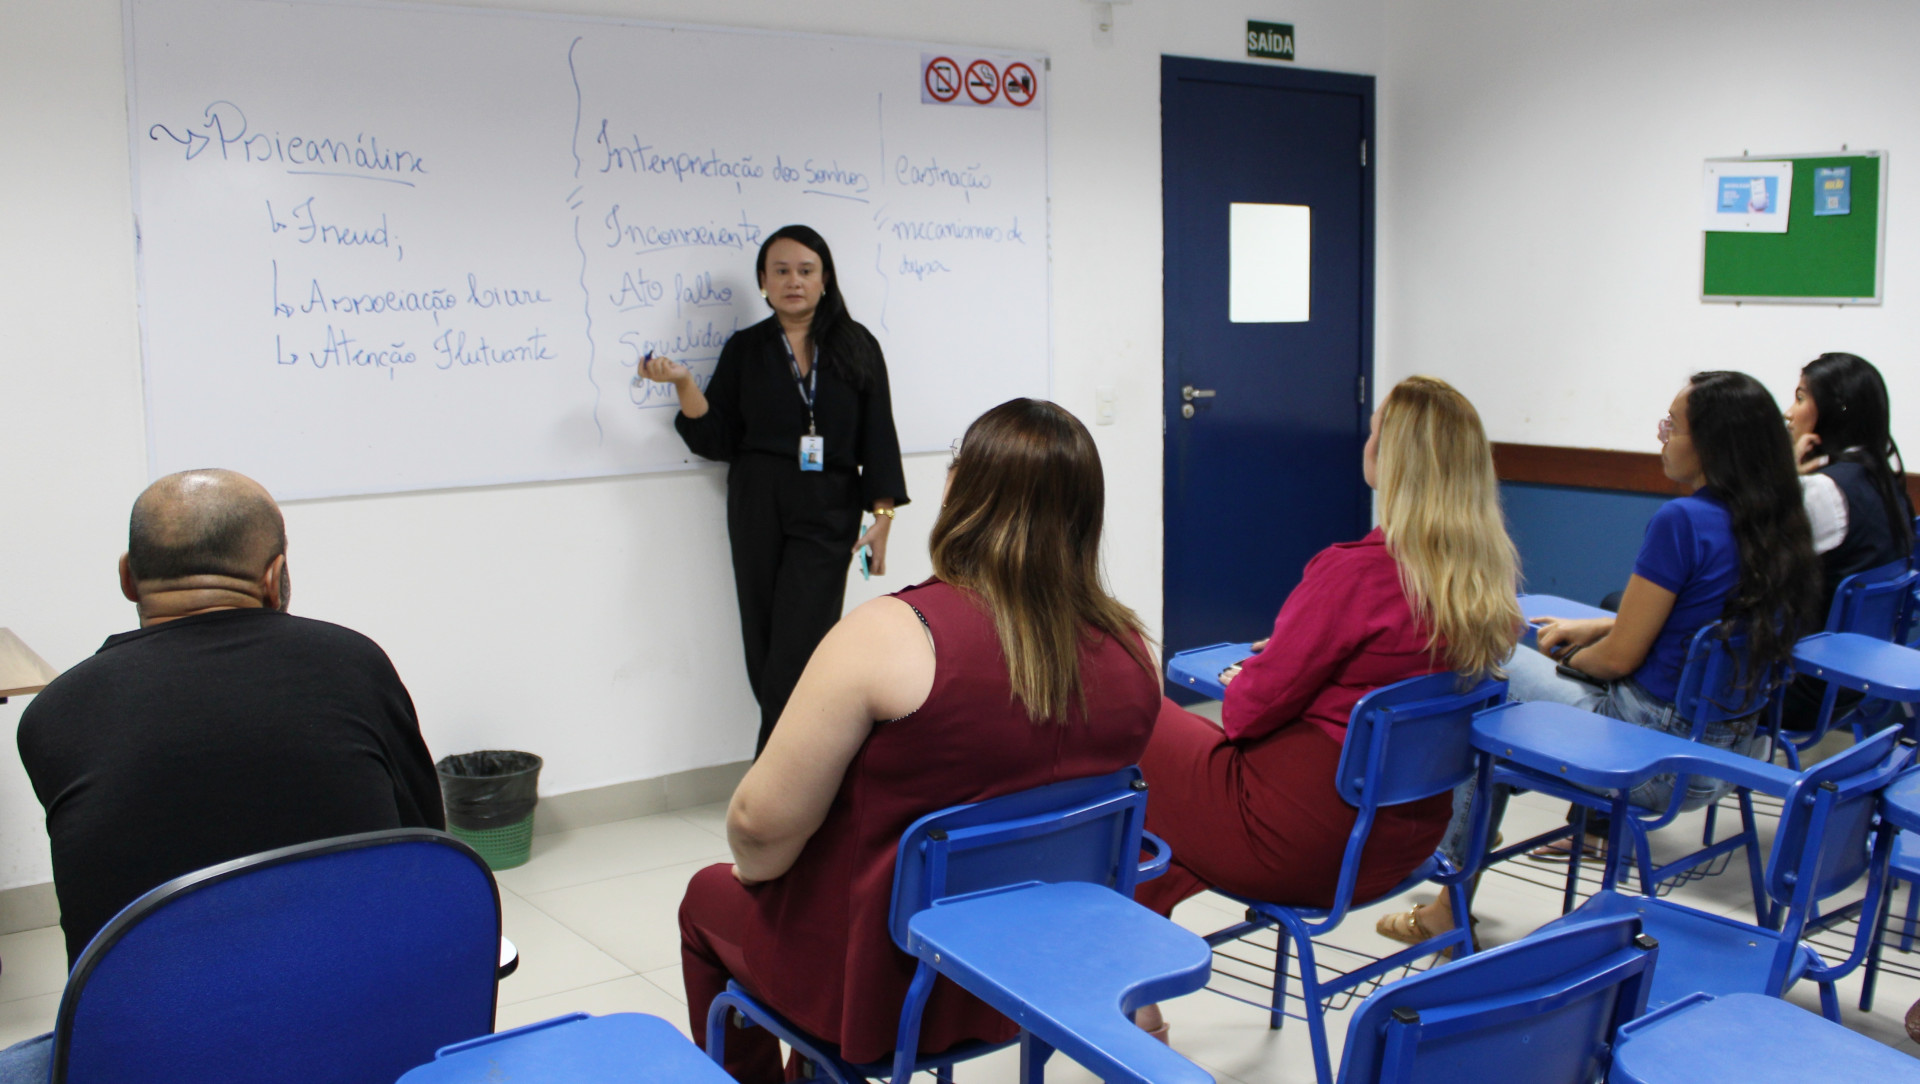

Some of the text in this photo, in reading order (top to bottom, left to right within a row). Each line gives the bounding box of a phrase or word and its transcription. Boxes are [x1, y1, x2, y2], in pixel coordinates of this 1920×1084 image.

[1248, 30, 1294, 54] SAÍDA
[204, 100, 429, 174] Psicanálise
[597, 118, 869, 194] Interpretação dos Sonhos
[895, 154, 992, 204] Castração
[604, 203, 762, 250] Inconsciente
[1007, 215, 1026, 244] de
[301, 278, 457, 325] Associação
[609, 267, 733, 320] Ato falho
[310, 324, 558, 380] Atenção Flutuante
